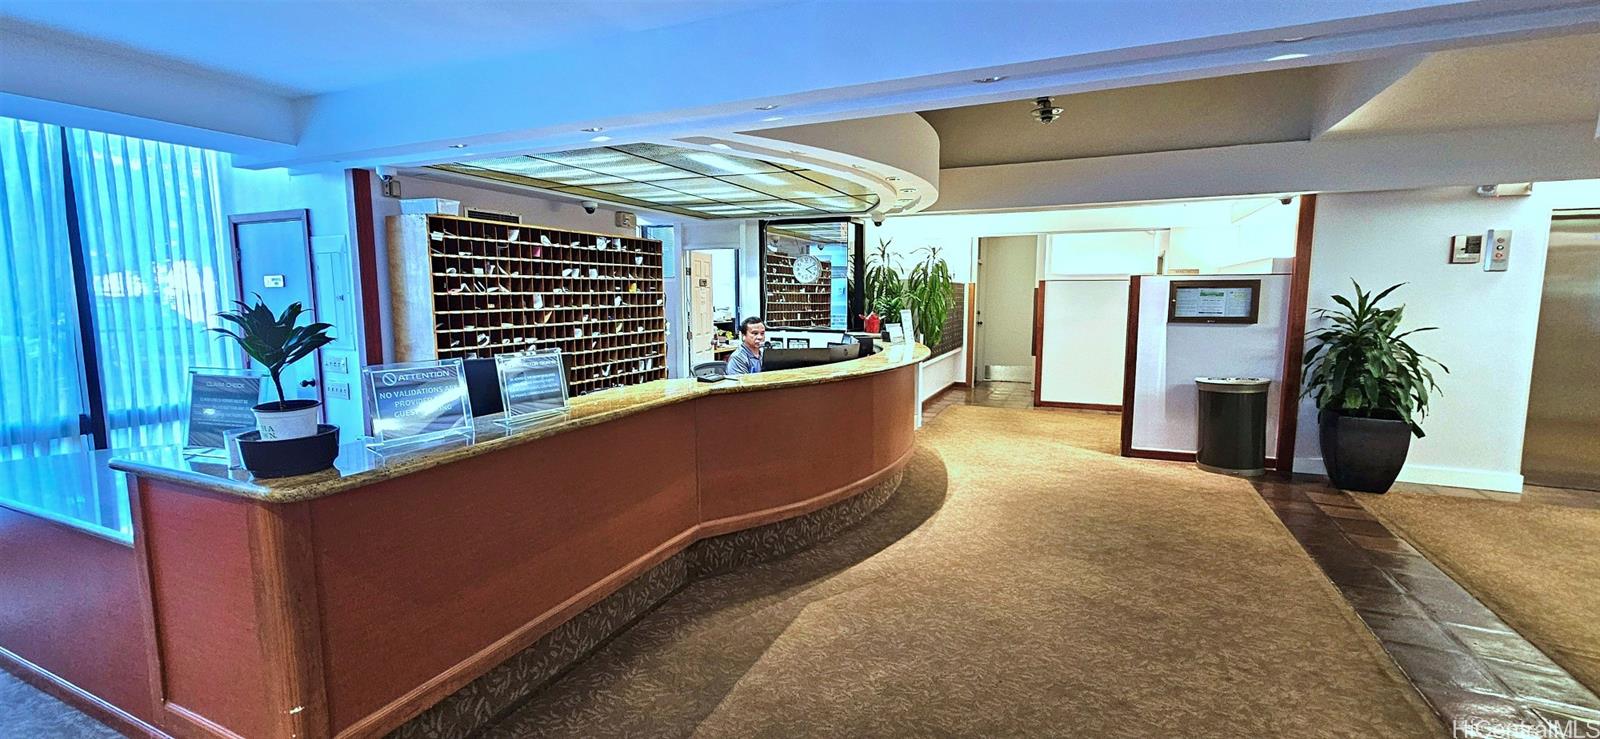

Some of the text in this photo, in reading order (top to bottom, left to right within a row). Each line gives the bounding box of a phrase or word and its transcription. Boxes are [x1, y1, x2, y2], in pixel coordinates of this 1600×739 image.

[398, 371, 449, 382] ATTENTION
[380, 391, 392, 400] NO
[393, 387, 443, 398] VALIDATIONS
